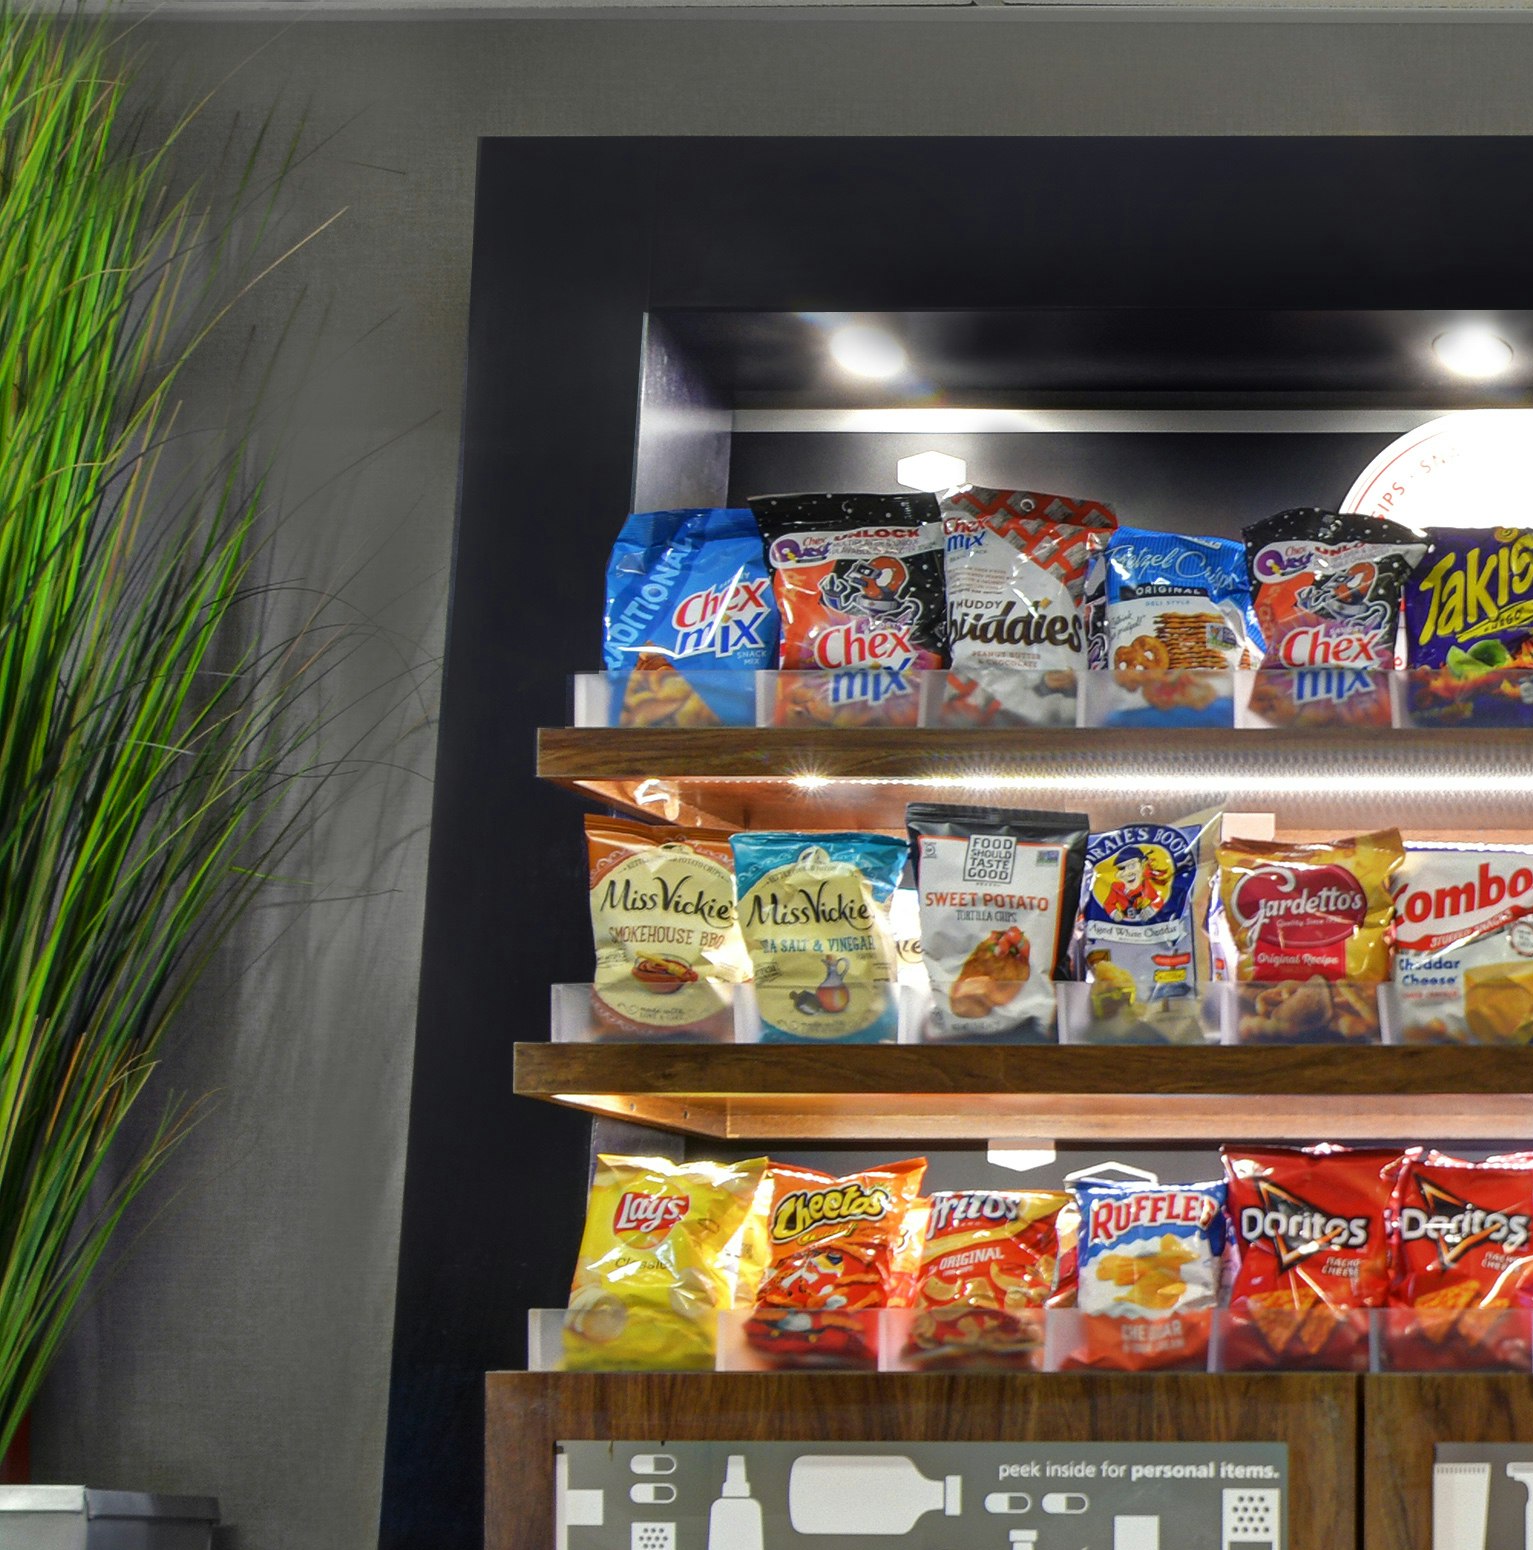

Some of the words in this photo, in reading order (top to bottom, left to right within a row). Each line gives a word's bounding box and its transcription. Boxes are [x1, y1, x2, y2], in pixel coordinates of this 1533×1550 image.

[943, 517, 986, 535] Chex
[946, 531, 987, 552] mix
[1135, 585, 1202, 596] ORIGINAL
[604, 537, 692, 675] RADITIONAL
[675, 580, 768, 628] Chex
[680, 612, 764, 655] mix
[817, 625, 912, 670] Chex
[1282, 625, 1378, 669] Chex
[832, 657, 911, 702] mix
[1296, 669, 1373, 702] mix
[971, 849, 1012, 860] SHOULD
[973, 837, 1013, 850] FOOD
[968, 868, 1009, 880] GOOD
[970, 858, 1011, 870] TASTE
[600, 878, 659, 912] Miss
[653, 875, 739, 929] Vickie'
[746, 892, 810, 928] Miss
[925, 891, 977, 908] SWEET
[983, 893, 1049, 911] POTATO
[1231, 866, 1364, 953] Gardetto's
[956, 910, 993, 922] TORTILLA
[608, 925, 695, 945] SMOKEHOUSE
[780, 938, 807, 952] SALT
[1257, 953, 1301, 967] Original
[1302, 954, 1340, 966] Recipe
[1398, 956, 1461, 972] Chddar
[1402, 973, 1458, 987] Cheese
[616, 1193, 689, 1232] Lay's
[771, 1184, 890, 1243] Cheetos
[1241, 1206, 1368, 1247] Doritos
[1400, 1206, 1530, 1245] Doritos
[939, 1246, 1005, 1271] ORIGINAL
[998, 1461, 1041, 1480] peek
[1045, 1460, 1096, 1479] inside
[1100, 1459, 1126, 1479] for
[1130, 1460, 1215, 1481] personal
[1219, 1461, 1280, 1480] items.
